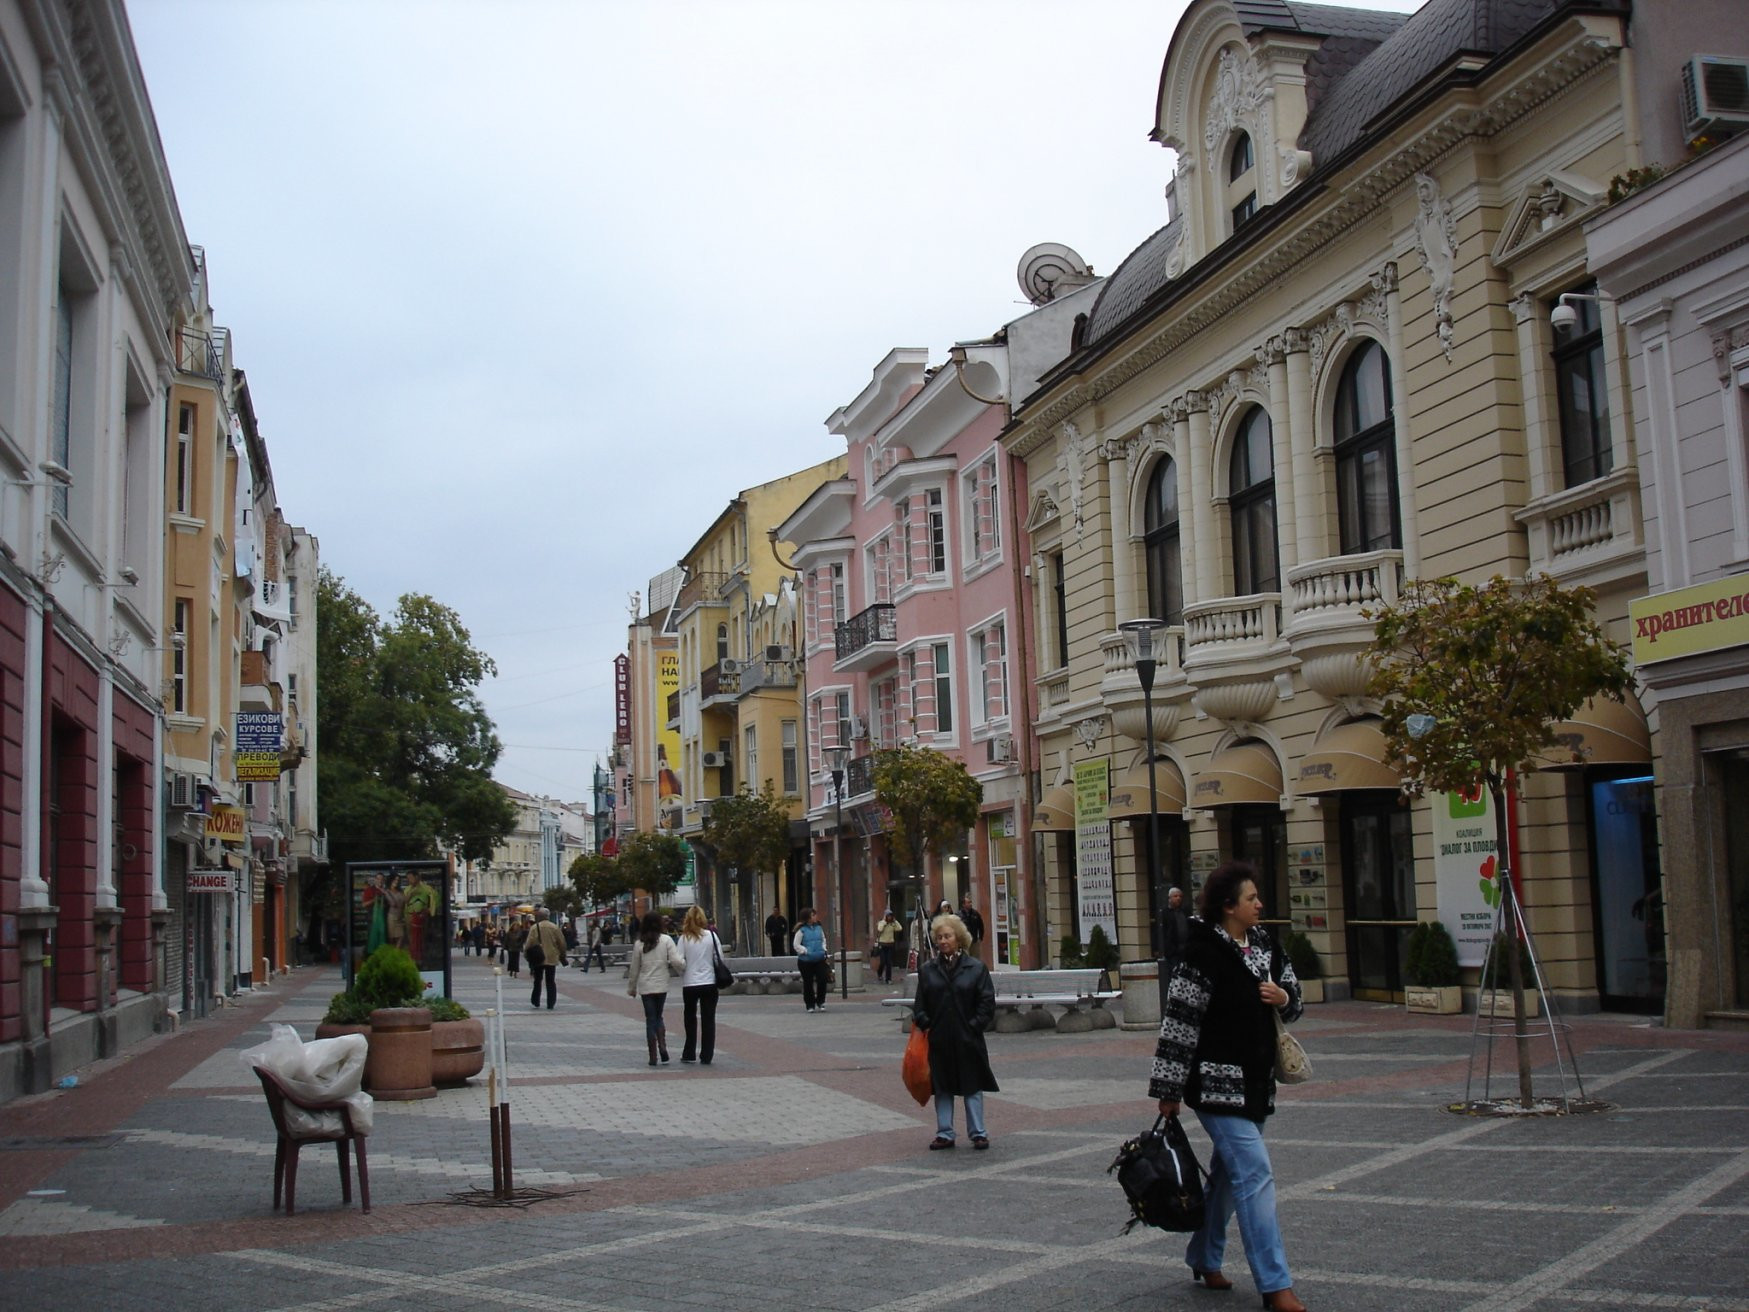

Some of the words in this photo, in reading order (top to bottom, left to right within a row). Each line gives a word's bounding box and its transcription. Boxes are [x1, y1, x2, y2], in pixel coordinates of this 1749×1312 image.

[237, 714, 280, 724] ЕЗИКОВИ
[238, 725, 279, 733] КУРСОВЕ
[237, 752, 280, 761] ПРЕВОДИ
[1464, 841, 1472, 853] ЗА
[1472, 839, 1498, 853] ПЛОВДИ
[187, 875, 227, 888] CHANGE
